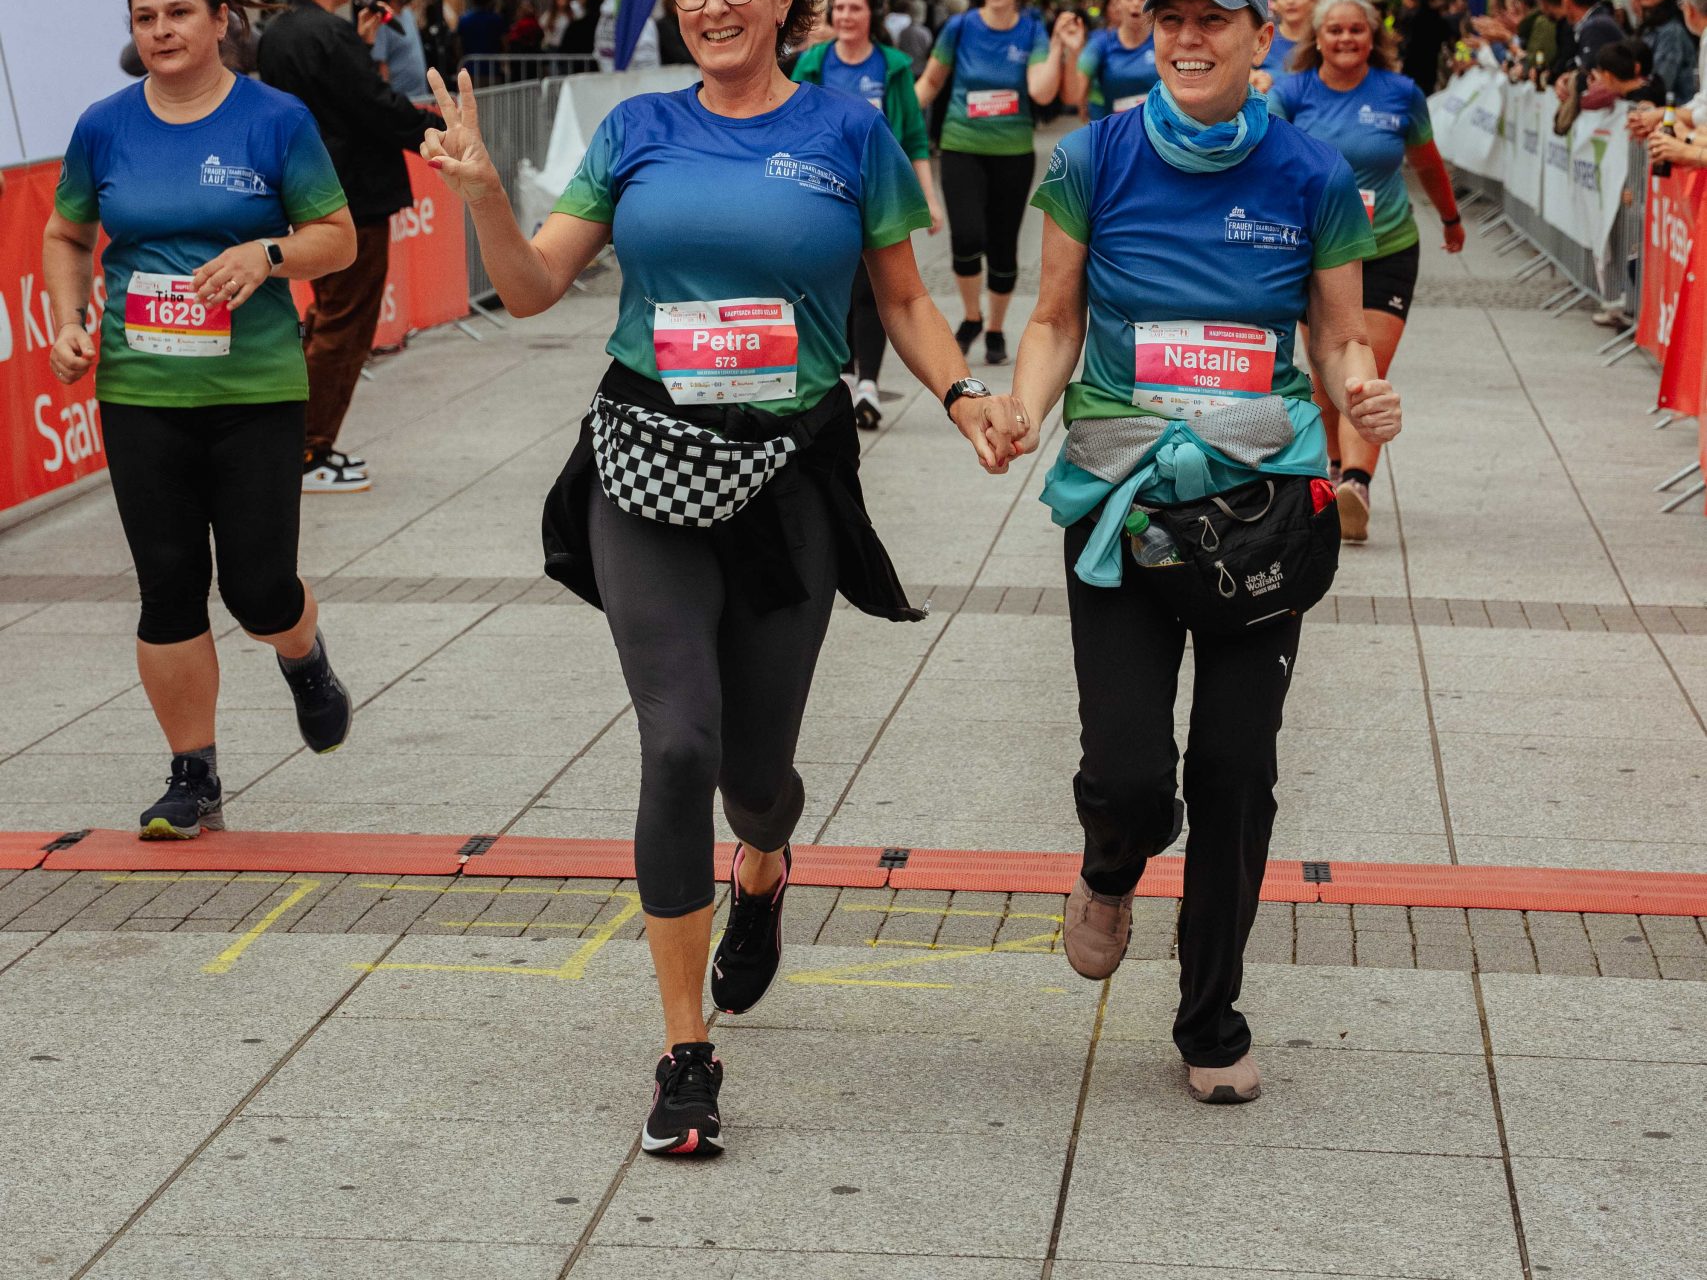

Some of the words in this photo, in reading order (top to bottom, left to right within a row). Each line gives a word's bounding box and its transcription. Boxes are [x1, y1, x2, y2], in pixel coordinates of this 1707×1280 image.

[770, 159, 798, 170] FRAUEN
[204, 167, 227, 176] FRAUEN
[768, 166, 797, 178] LAUF
[203, 175, 225, 184] LAUF
[1228, 221, 1253, 231] FRAUEN
[1228, 230, 1252, 241] LAUF
[156, 290, 185, 302] Tina
[145, 300, 206, 326] 1629
[692, 330, 761, 352] Petra
[715, 356, 737, 368] 573
[1164, 345, 1250, 373] Natalie
[1193, 374, 1221, 388] 1082
[1245, 571, 1267, 584] Jack
[1245, 572, 1284, 592] Wolfskin
